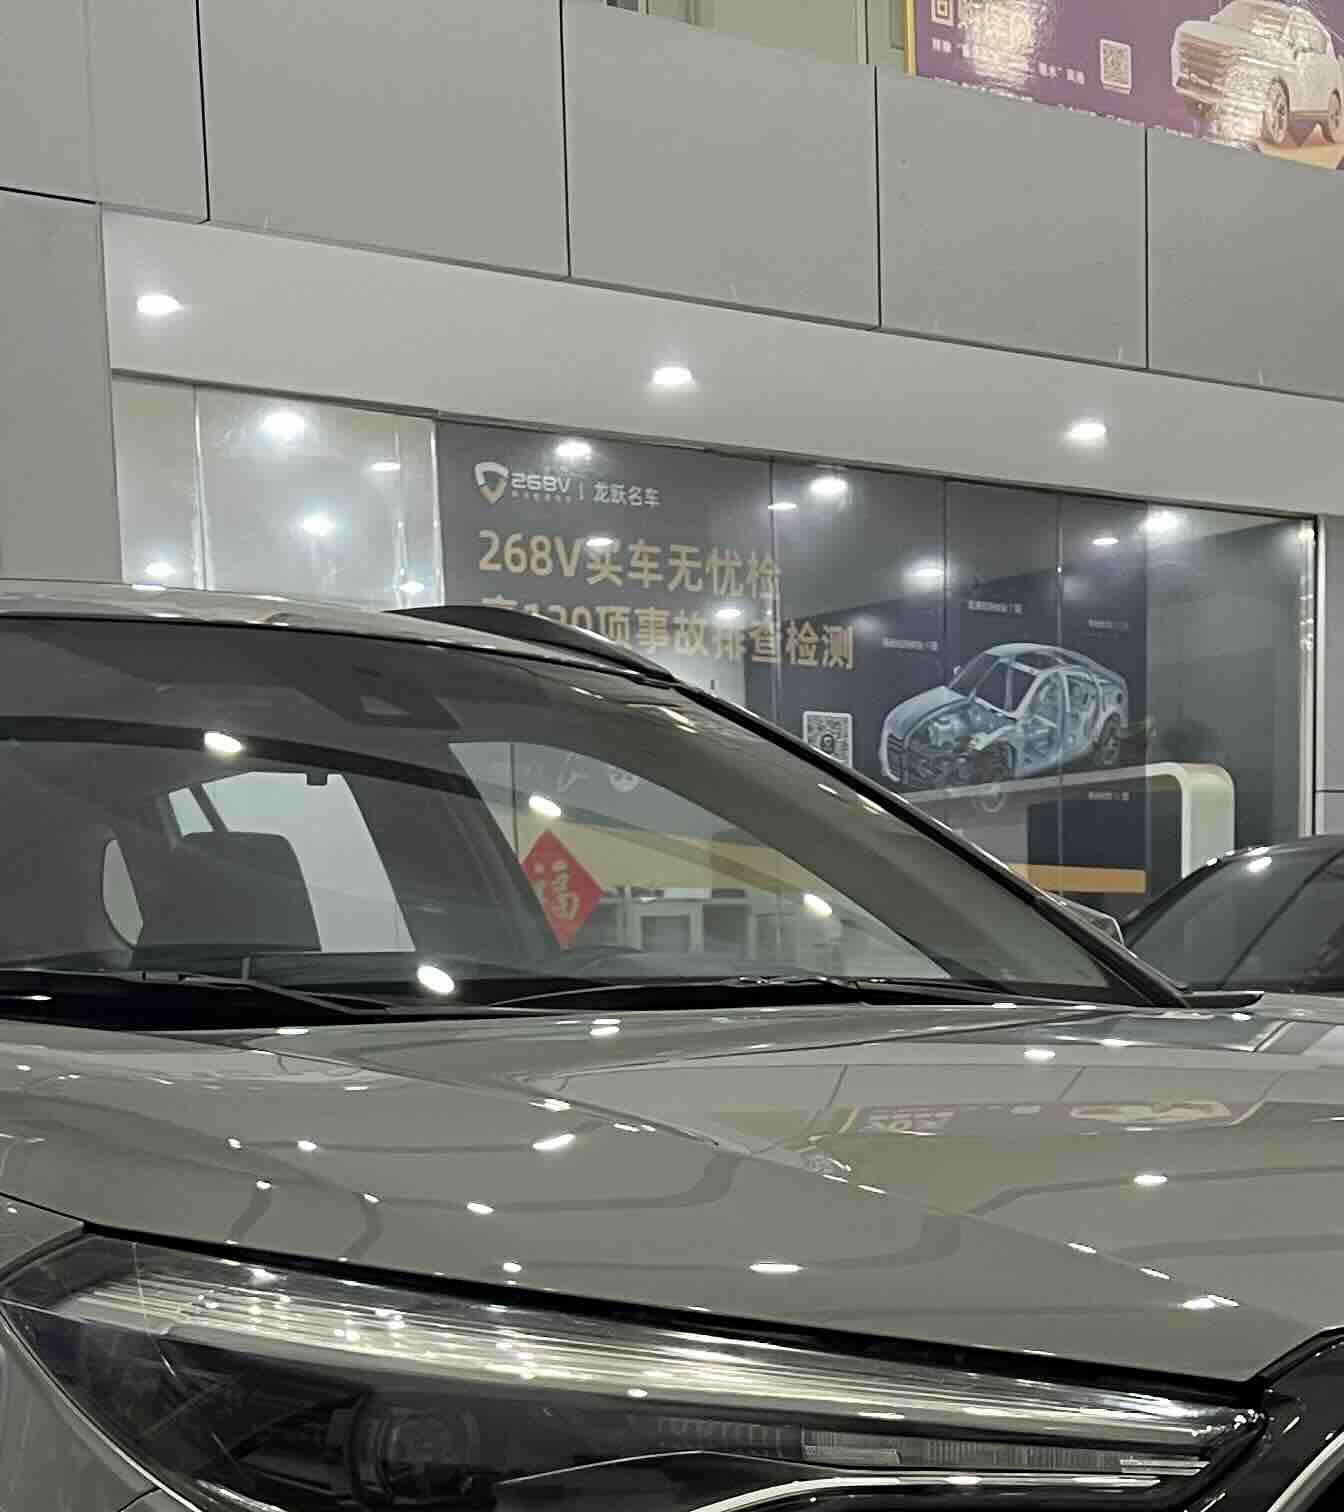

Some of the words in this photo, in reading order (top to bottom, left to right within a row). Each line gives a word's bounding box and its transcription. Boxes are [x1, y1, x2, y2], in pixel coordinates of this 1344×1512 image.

[511, 473, 570, 493] 268V
[592, 480, 660, 506] 龙跃名车
[478, 529, 782, 601] 268V买车无忧检
